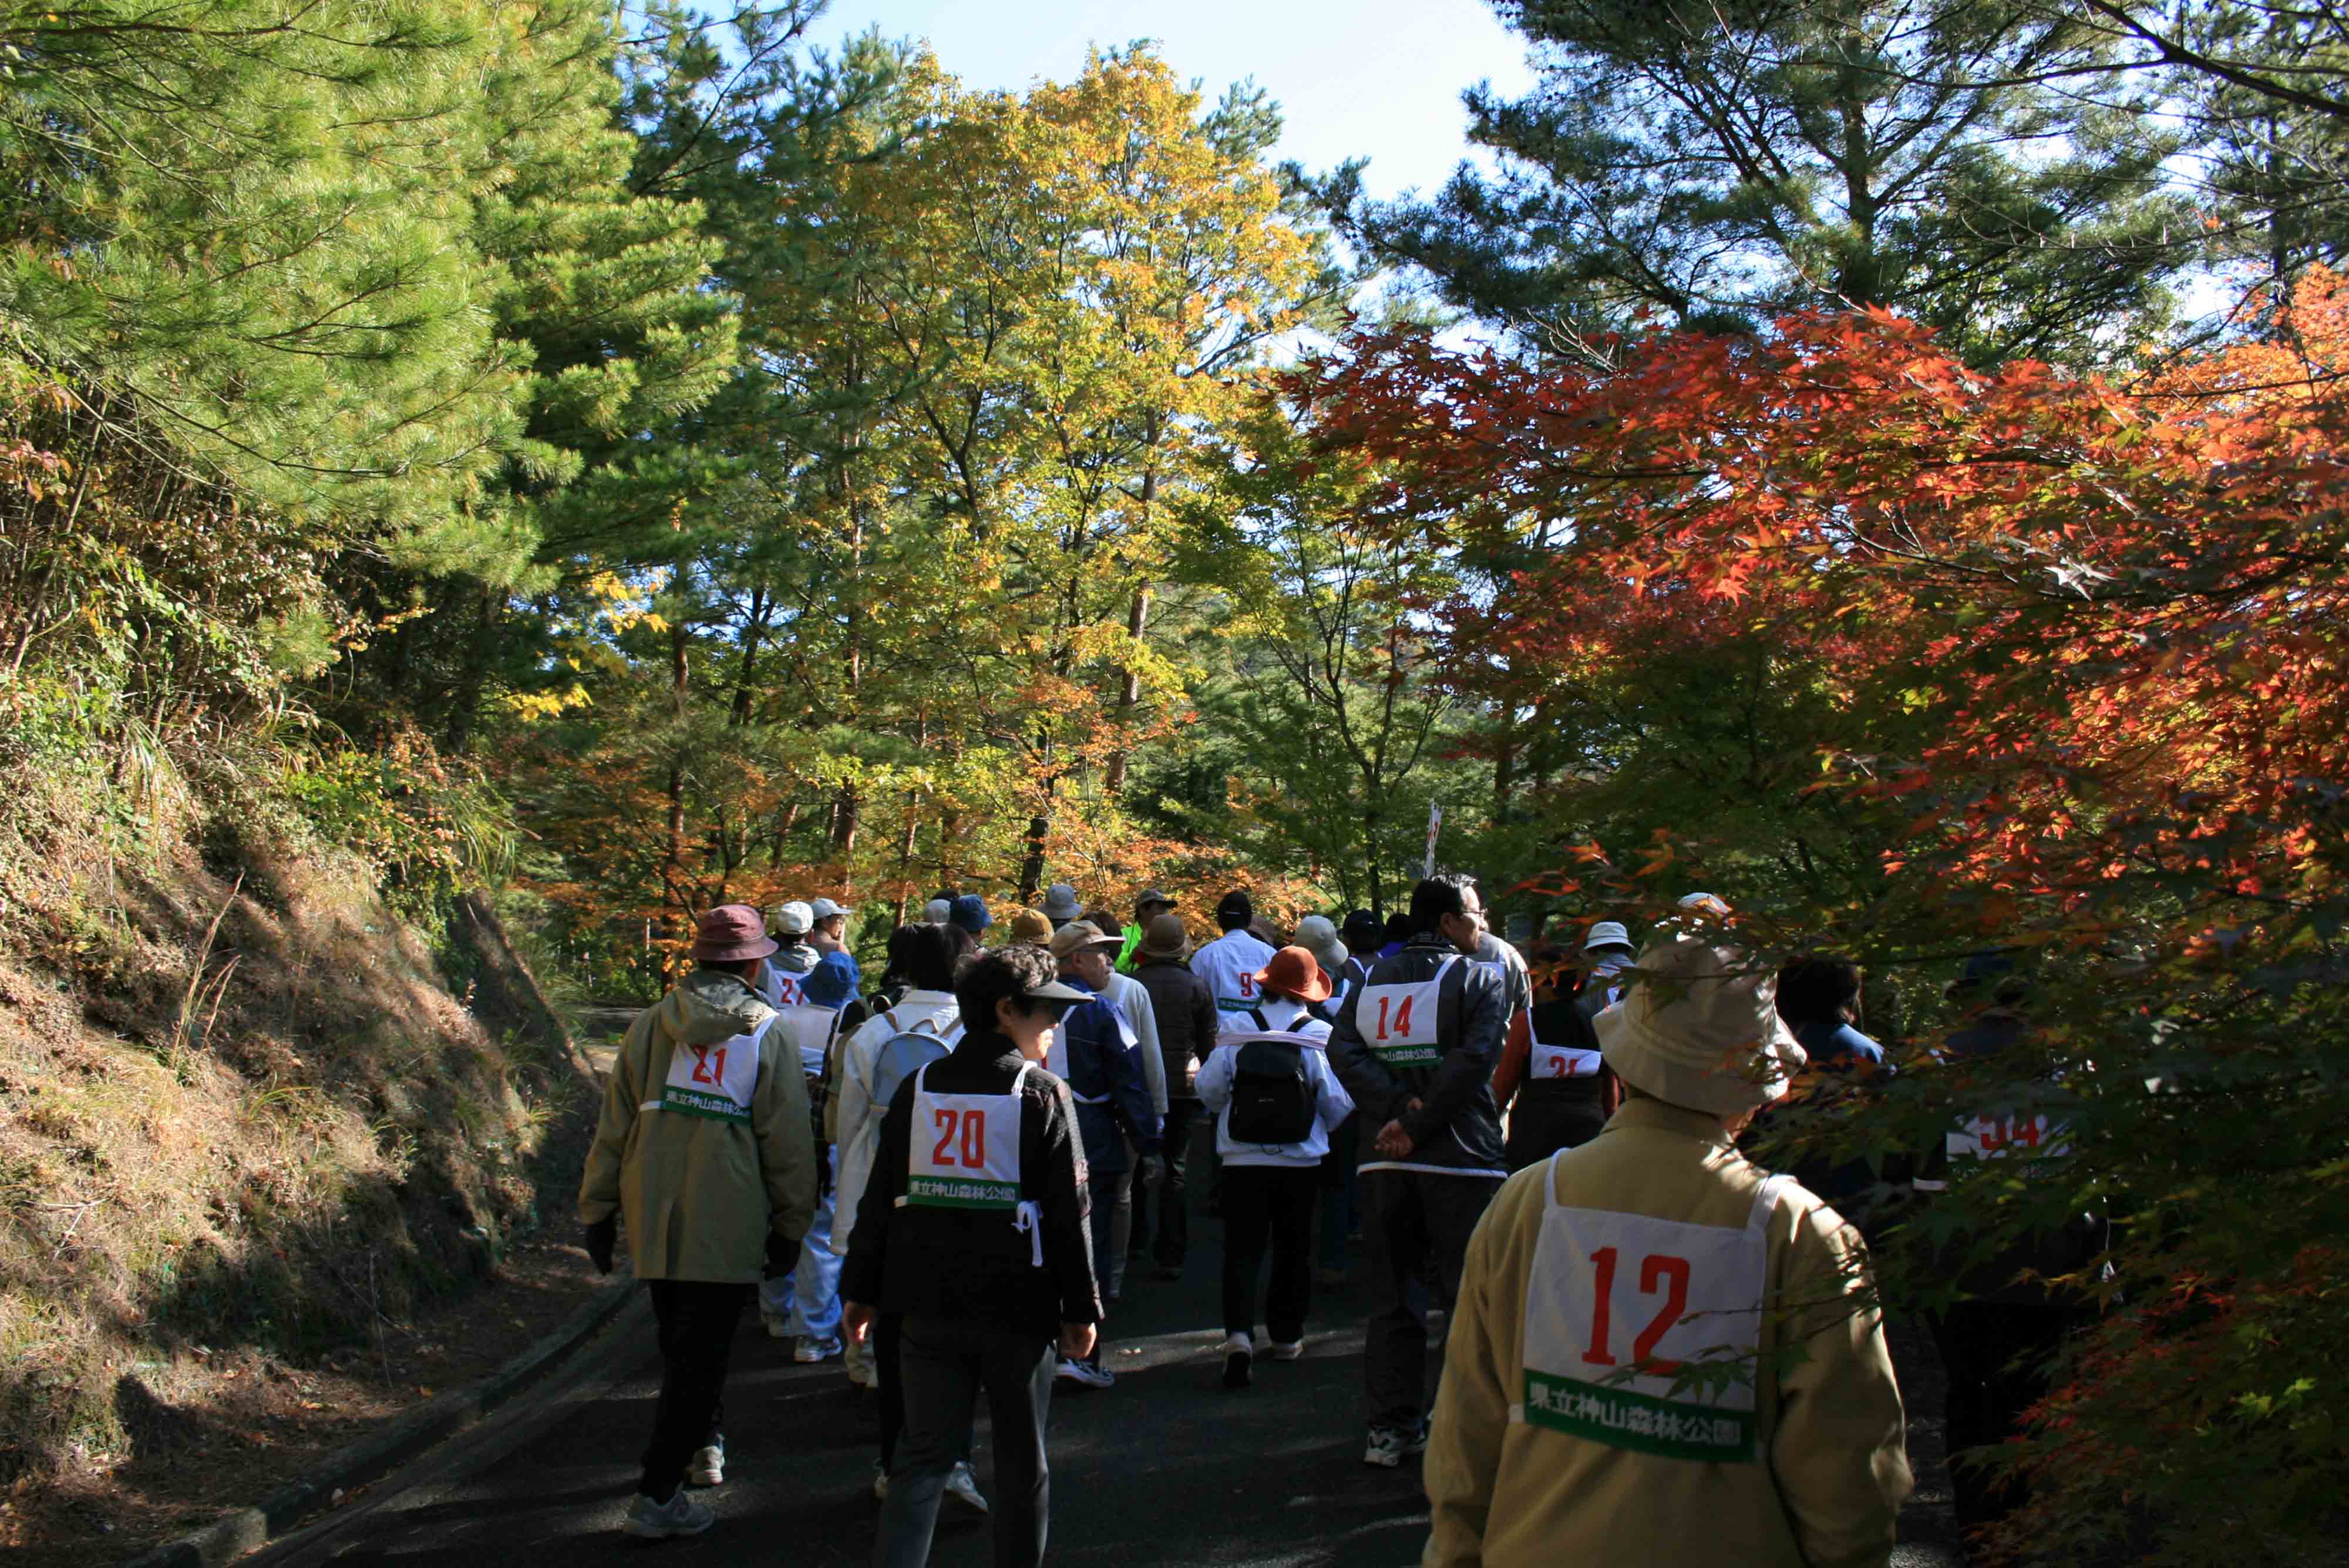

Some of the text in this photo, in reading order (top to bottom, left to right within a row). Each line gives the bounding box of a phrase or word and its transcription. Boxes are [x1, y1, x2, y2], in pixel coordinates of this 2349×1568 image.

[1240, 972, 1252, 997] 9
[1376, 995, 1413, 1040] 14
[692, 1043, 727, 1086] 21
[933, 1109, 984, 1168] 20
[1582, 1246, 1690, 1375] 12
[1530, 1381, 1742, 1446] 県立神山森林公園
